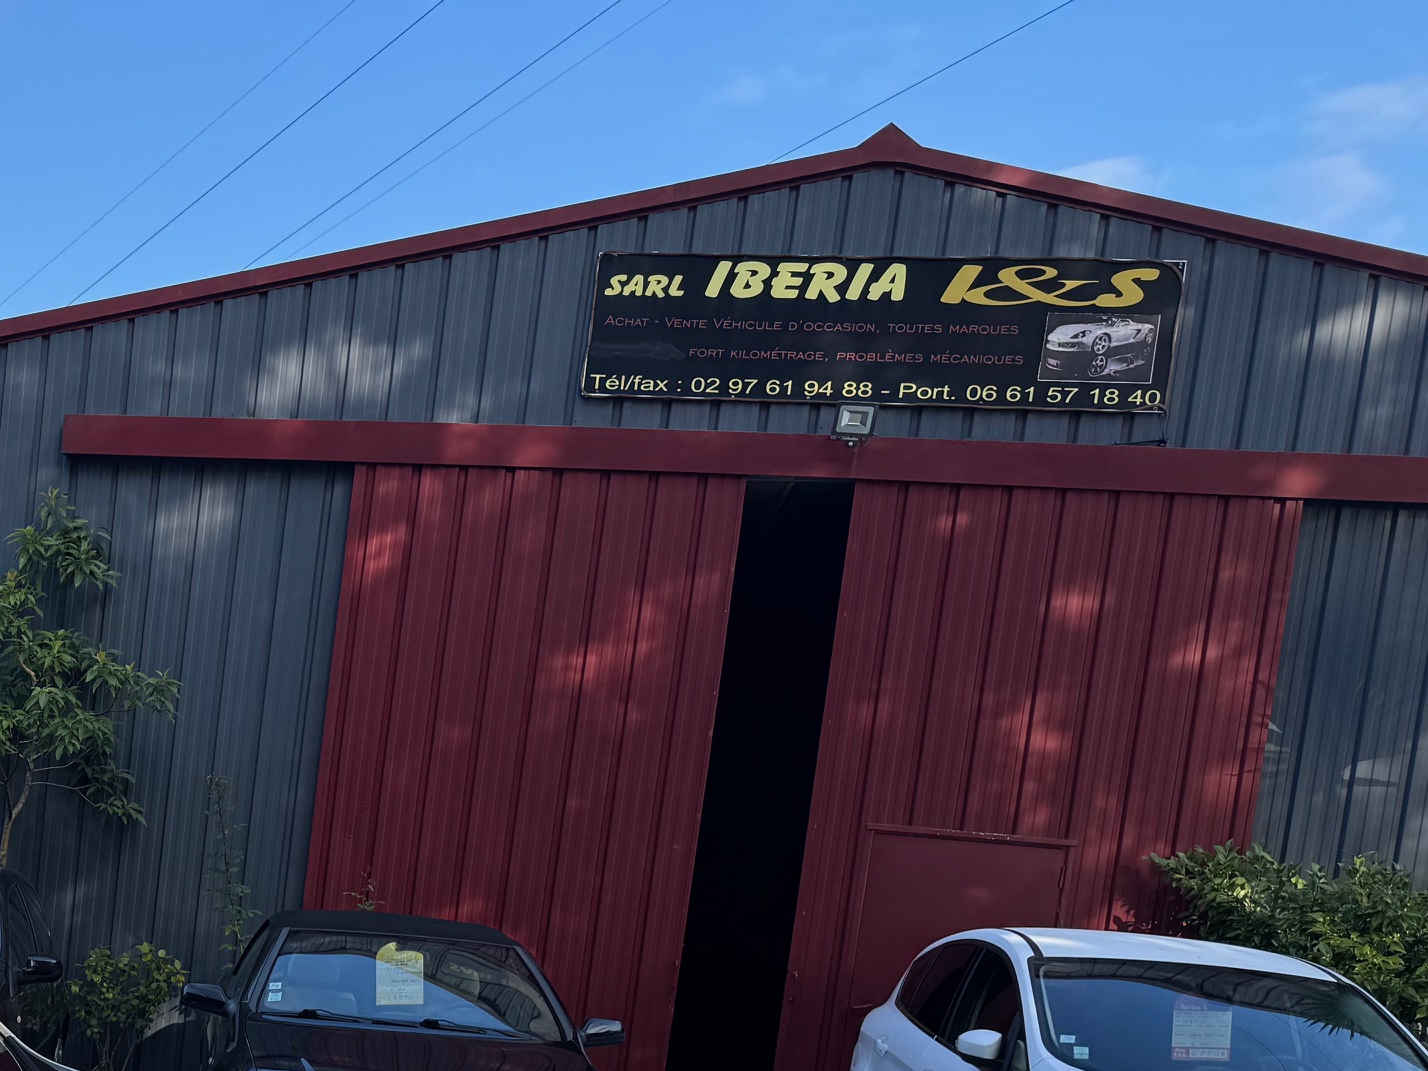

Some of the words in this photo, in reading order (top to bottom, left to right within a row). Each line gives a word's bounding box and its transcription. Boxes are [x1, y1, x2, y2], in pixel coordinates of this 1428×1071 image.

[604, 274, 684, 298] SARL
[704, 261, 906, 303] IBERIA
[605, 315, 649, 327] ACHAT
[664, 317, 707, 329] VENTE
[714, 317, 782, 331] VÉHICULE
[888, 323, 942, 335] TOUTES
[950, 324, 1019, 336] MARQUES
[689, 348, 724, 359] FORT
[730, 347, 829, 362] KILOMÉTRAGE,
[836, 350, 923, 364] PROBLÈMES
[930, 351, 1023, 366] MÉCANIQUES
[590, 374, 668, 392] Tél/fax
[690, 377, 719, 394] 02
[728, 379, 758, 395] 97
[765, 379, 792, 396] 61
[804, 380, 834, 397] 94
[842, 381, 872, 398] 88
[898, 382, 956, 400] Port.
[966, 384, 997, 402] 06
[1006, 386, 1035, 402] 61
[1046, 387, 1079, 404] 57
[1089, 388, 1119, 404] 18
[1127, 389, 1161, 406] 40
